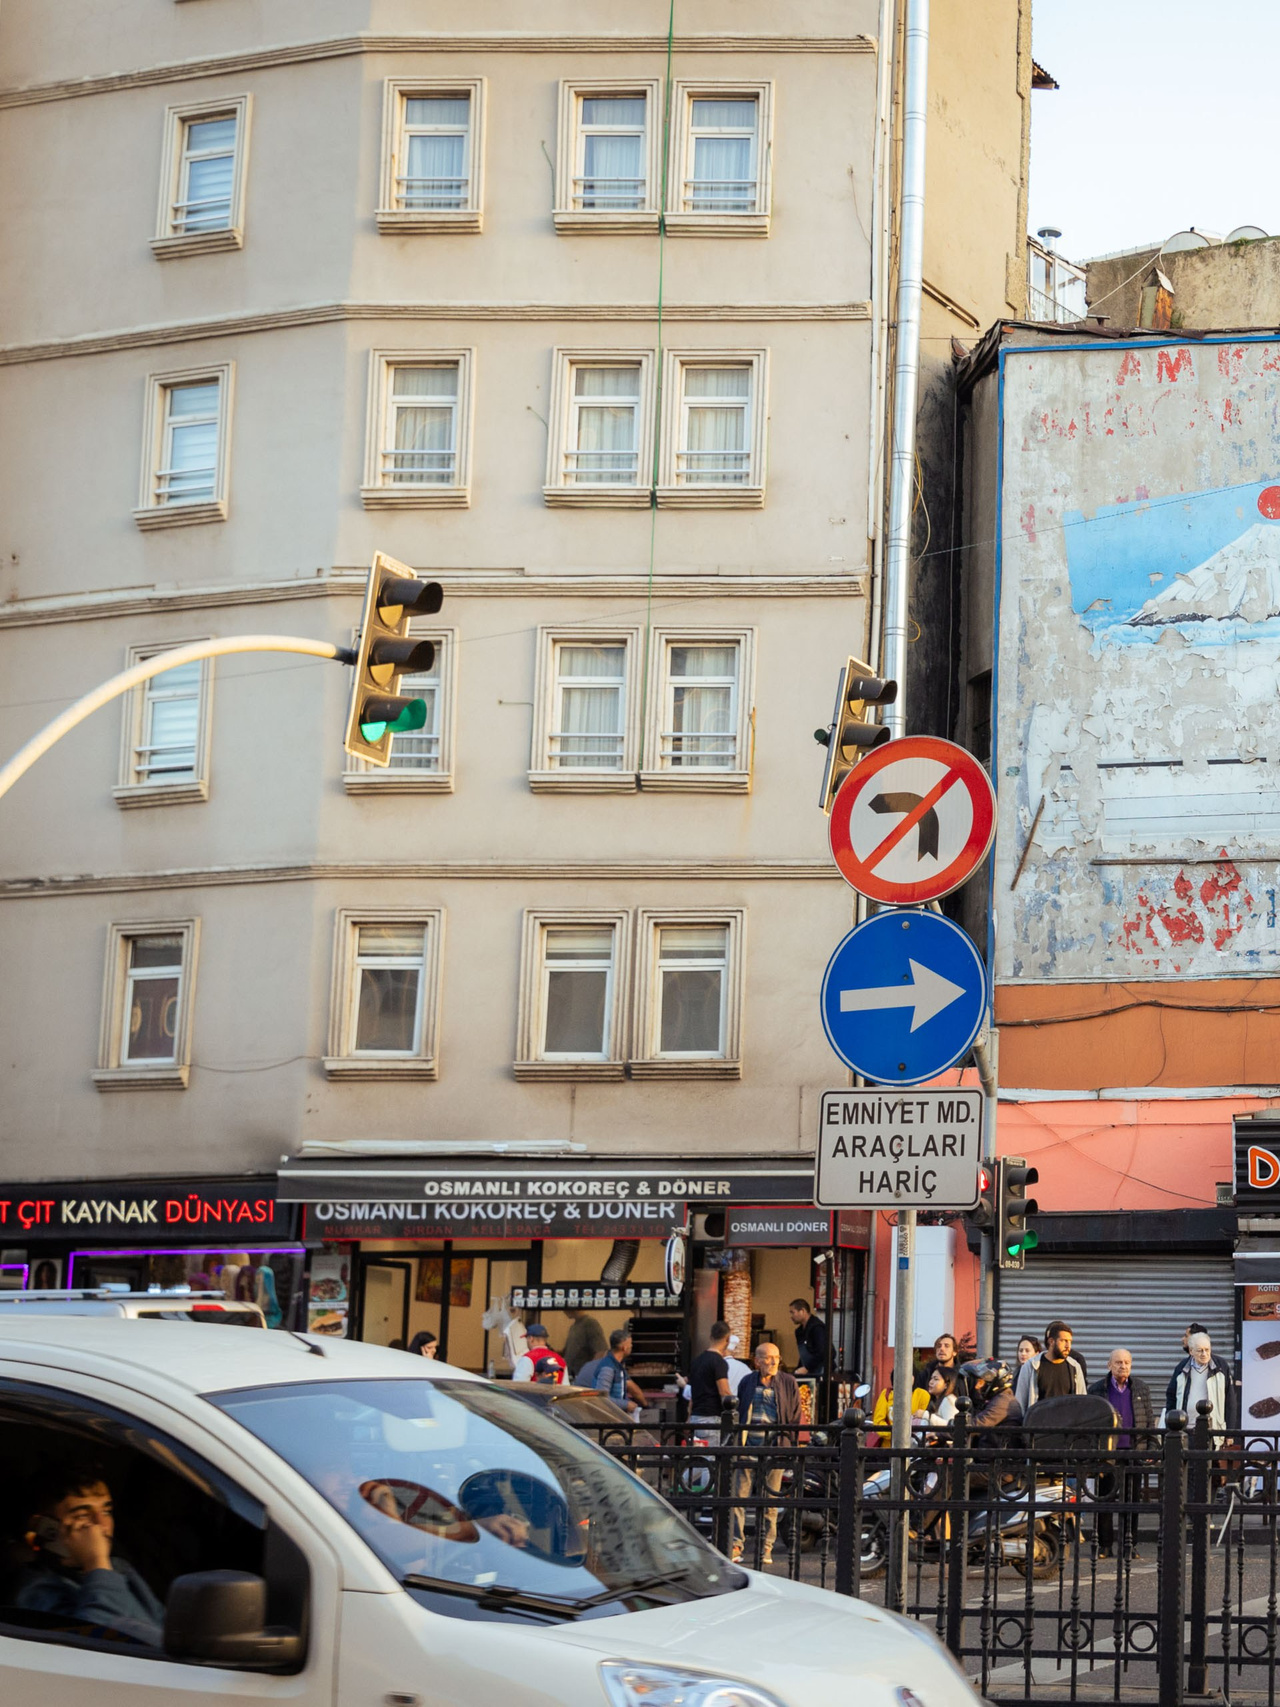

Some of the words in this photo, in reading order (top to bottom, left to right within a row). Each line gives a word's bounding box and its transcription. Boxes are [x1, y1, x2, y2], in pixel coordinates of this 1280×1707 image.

[826, 1097, 930, 1125] EMNİYET
[937, 1100, 975, 1123] MD.
[831, 1134, 966, 1163] ARAÇLARI
[424, 1181, 521, 1196] OSMANLI
[527, 1181, 630, 1199] KOKOREÇ
[636, 1181, 652, 1196] &
[658, 1179, 731, 1196] DÖNER
[859, 1165, 937, 1198] HARİÇ
[17, 1200, 55, 1230] ÇIT
[61, 1199, 158, 1224] KAYNAK
[165, 1194, 275, 1224] DÜNYASI
[315, 1202, 427, 1221] OSMANLI
[434, 1201, 557, 1224] KOKOREÇ
[563, 1201, 581, 1220] &
[730, 1221, 785, 1233] OSMANLI
[786, 1220, 829, 1232] DÖNER
